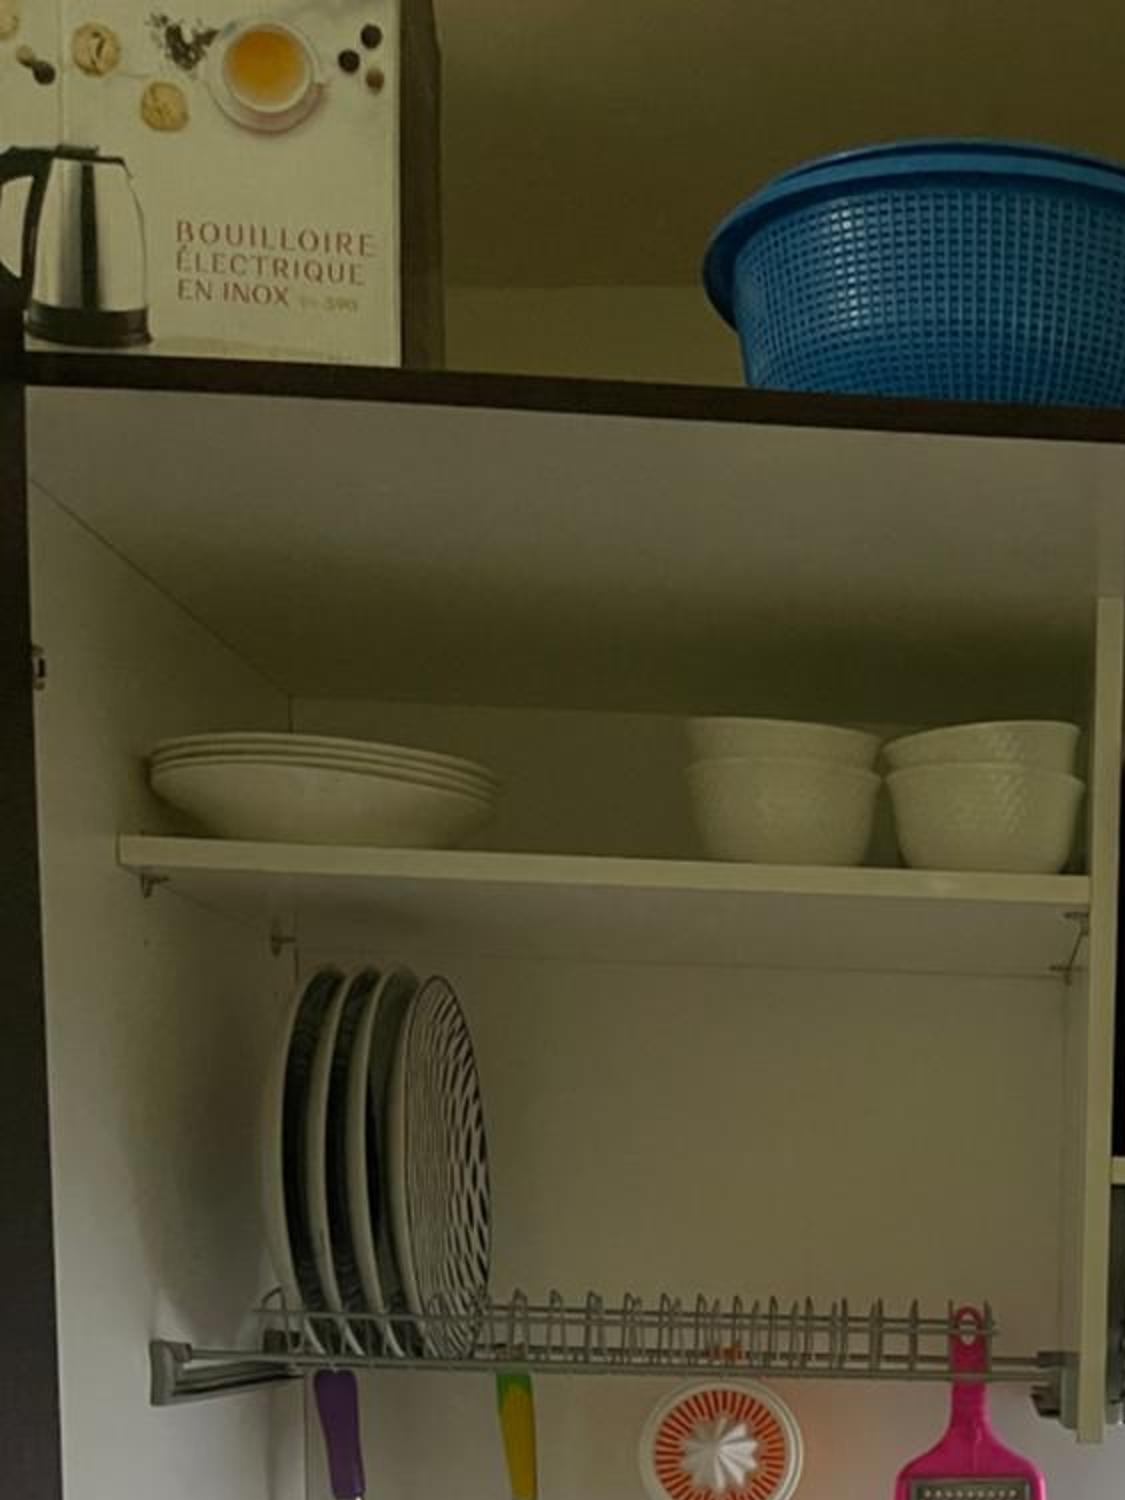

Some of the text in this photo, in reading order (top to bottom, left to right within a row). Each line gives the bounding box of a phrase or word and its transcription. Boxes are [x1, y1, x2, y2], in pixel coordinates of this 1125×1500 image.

[176, 220, 378, 258] BOUILLOIRE
[176, 244, 365, 287] ÉLECTRIQUE
[177, 278, 213, 302] EN
[222, 281, 289, 307] INOX
